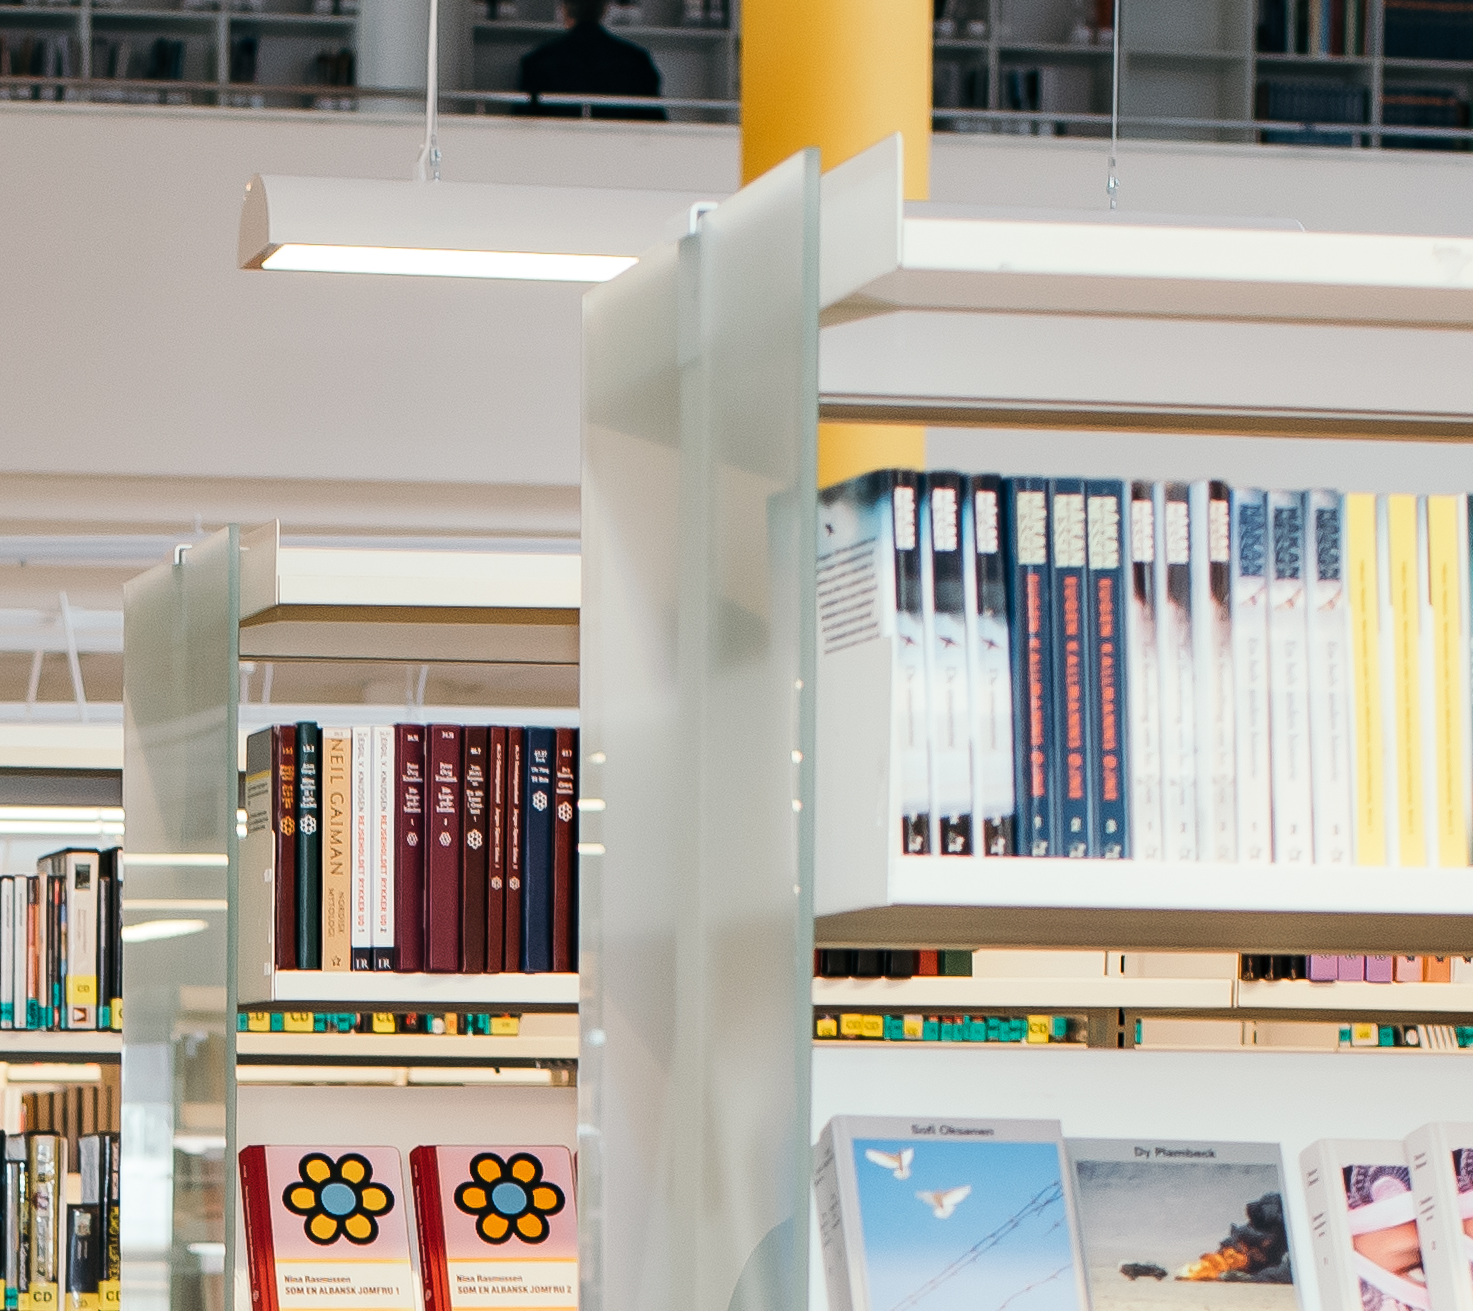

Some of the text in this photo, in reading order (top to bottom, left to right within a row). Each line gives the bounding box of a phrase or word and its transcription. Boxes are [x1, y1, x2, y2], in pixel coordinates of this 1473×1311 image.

[329, 739, 344, 876] NEIL GAIMAN
[284, 1275, 351, 1283] Nina Rasmussen
[285, 1286, 305, 1295] SOM
[319, 1286, 356, 1295] ALBANSK
[33, 1291, 52, 1303] CD
